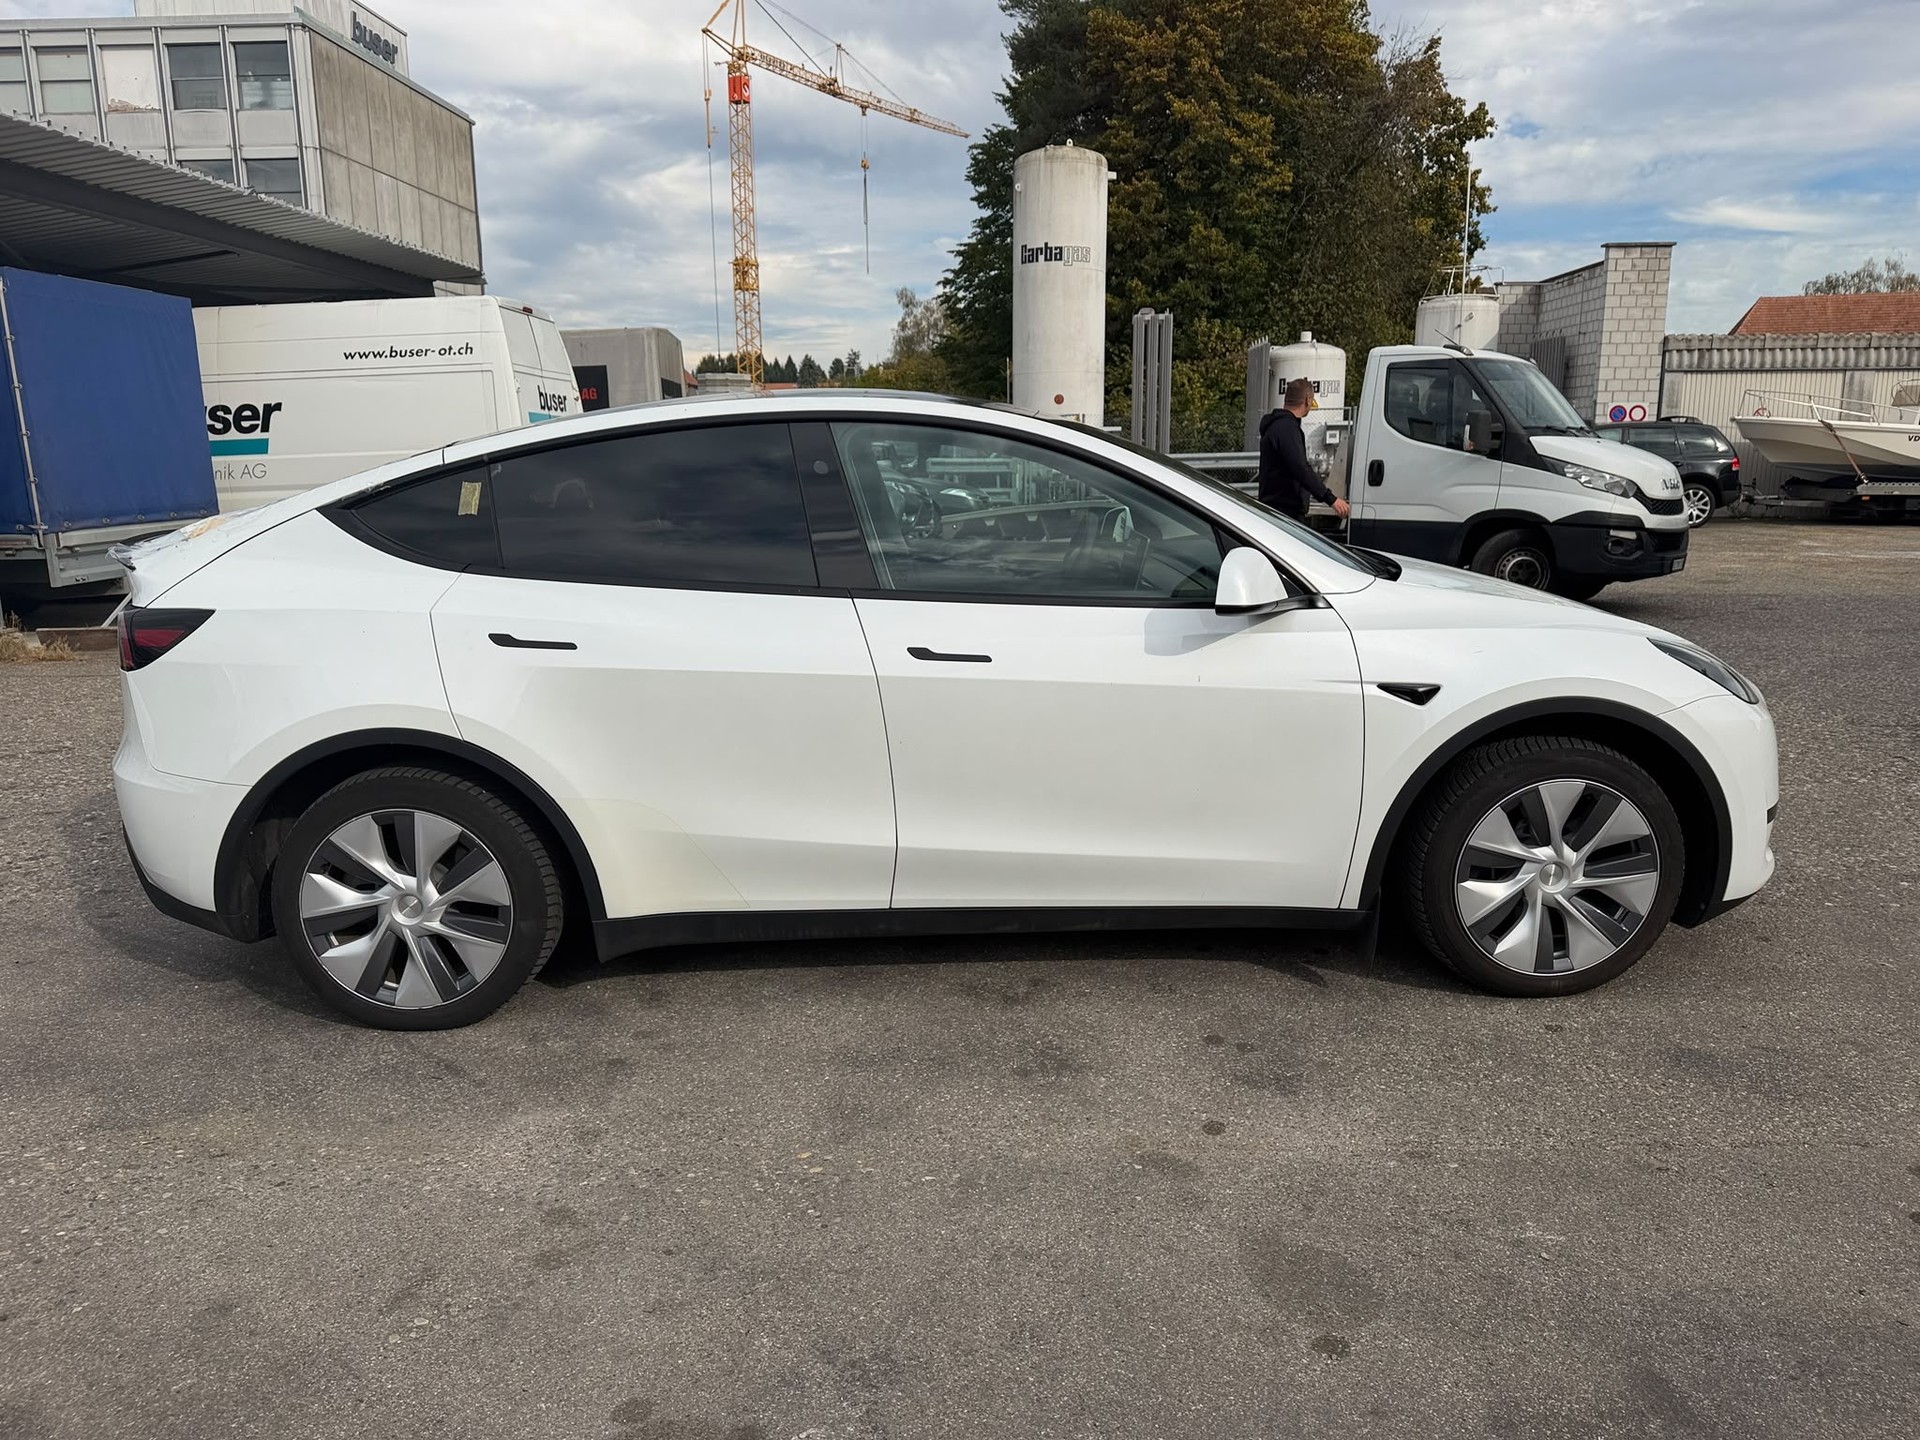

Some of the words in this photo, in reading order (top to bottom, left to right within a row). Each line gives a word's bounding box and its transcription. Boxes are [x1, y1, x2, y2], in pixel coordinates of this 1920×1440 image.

[352, 10, 398, 64] buser
[1021, 242, 1091, 266] Carbagas
[537, 385, 567, 412] buser
[581, 387, 598, 400] AG
[204, 402, 282, 435] ser
[214, 463, 235, 480] nik
[240, 463, 267, 479] AG
